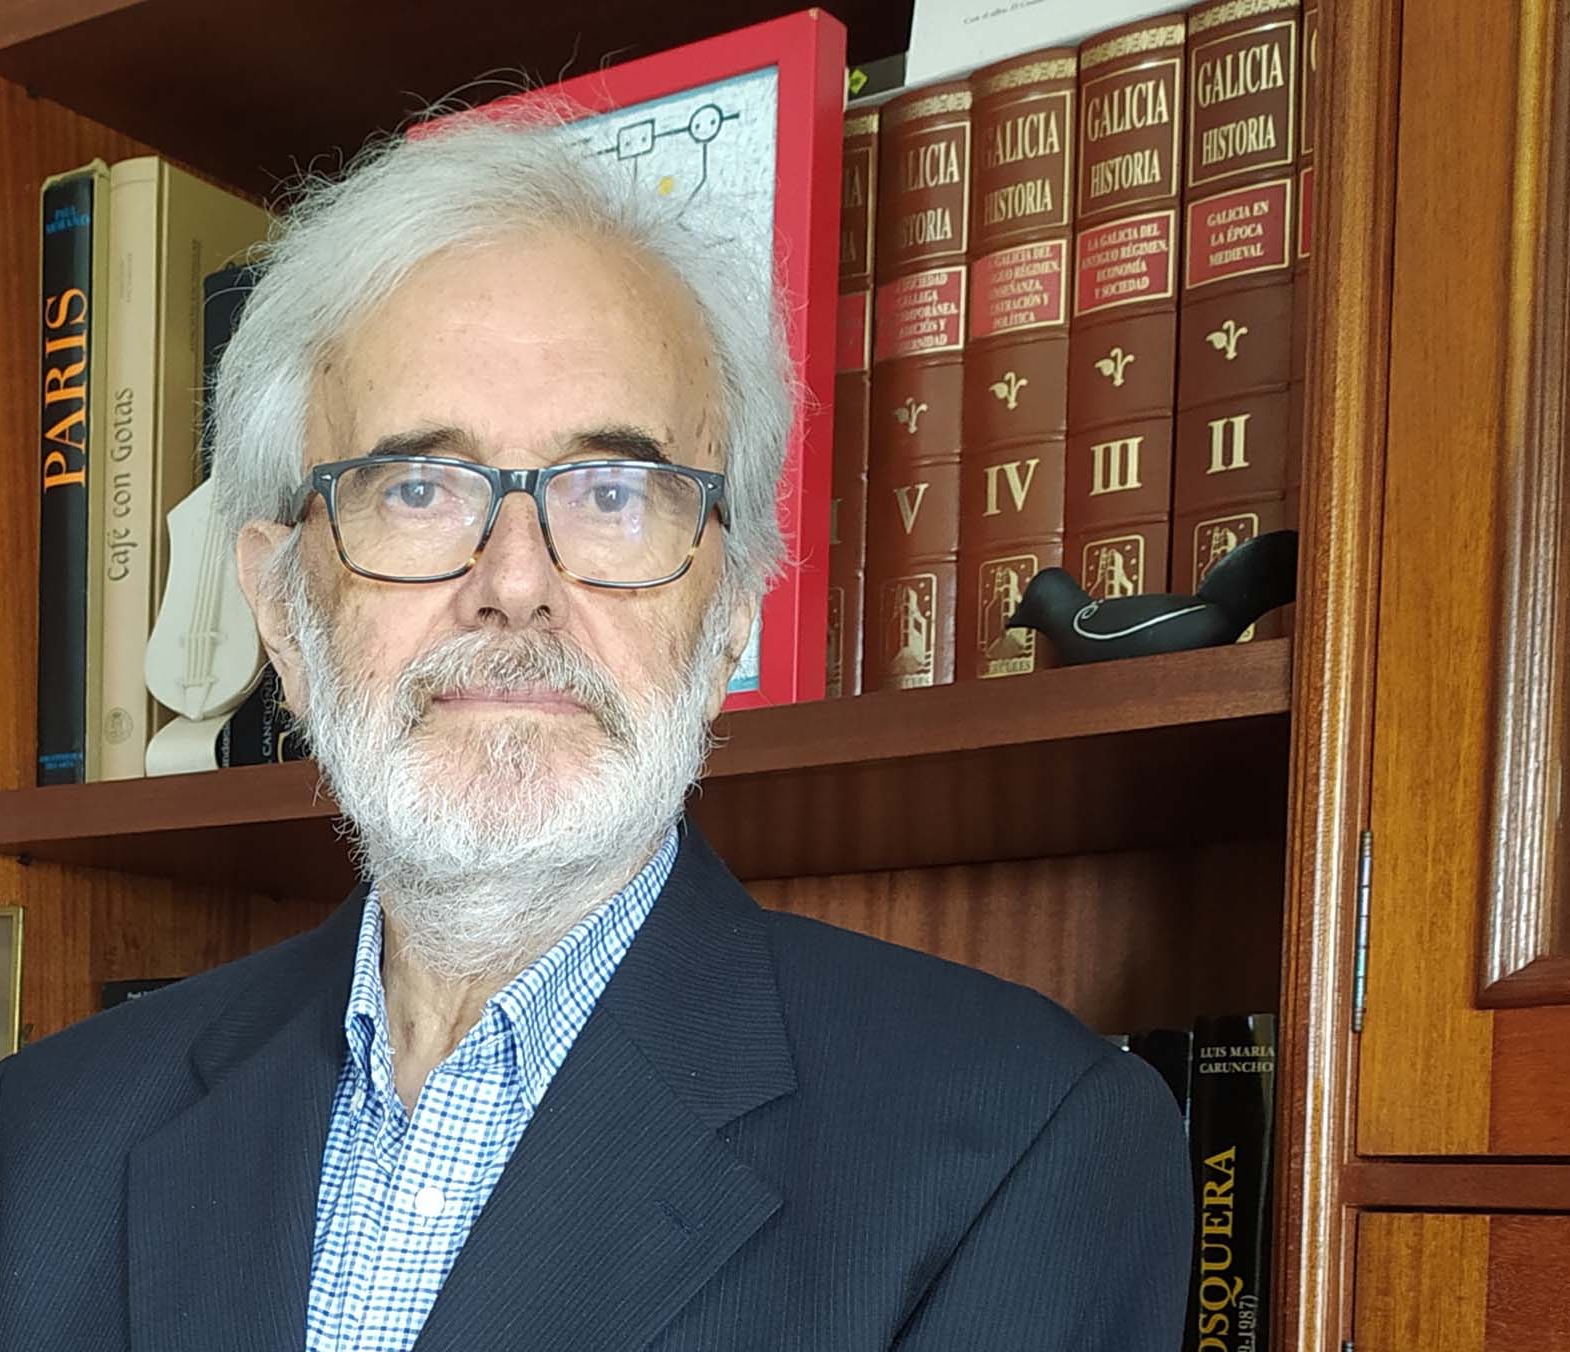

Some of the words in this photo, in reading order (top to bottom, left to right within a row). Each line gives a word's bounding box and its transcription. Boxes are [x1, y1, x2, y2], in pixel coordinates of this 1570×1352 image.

[1197, 42, 1284, 108] GALICIA
[1087, 78, 1170, 142] GALICIA
[1202, 114, 1277, 166] HISTORIA
[902, 141, 961, 192] LICIA
[1090, 149, 1162, 199] HISTORIA
[900, 207, 954, 248] STORIA
[984, 178, 1054, 226] HISTORIA
[1207, 204, 1251, 228] GALICIA
[1253, 200, 1270, 216] EN
[1209, 243, 1264, 267] MEDIEVAL
[1210, 231, 1226, 247] LA
[43, 288, 89, 495] PARIS
[109, 387, 134, 462] Gotas
[1206, 414, 1251, 474] II
[982, 458, 1041, 518] IV
[1090, 437, 1144, 496] III
[111, 472, 132, 518] con
[893, 483, 929, 535] V
[107, 528, 138, 582] Café
[1199, 1062, 1275, 1074] CARUNCHO
[1200, 1047, 1227, 1059] LUIS
[1230, 1046, 1275, 1058] MARIA
